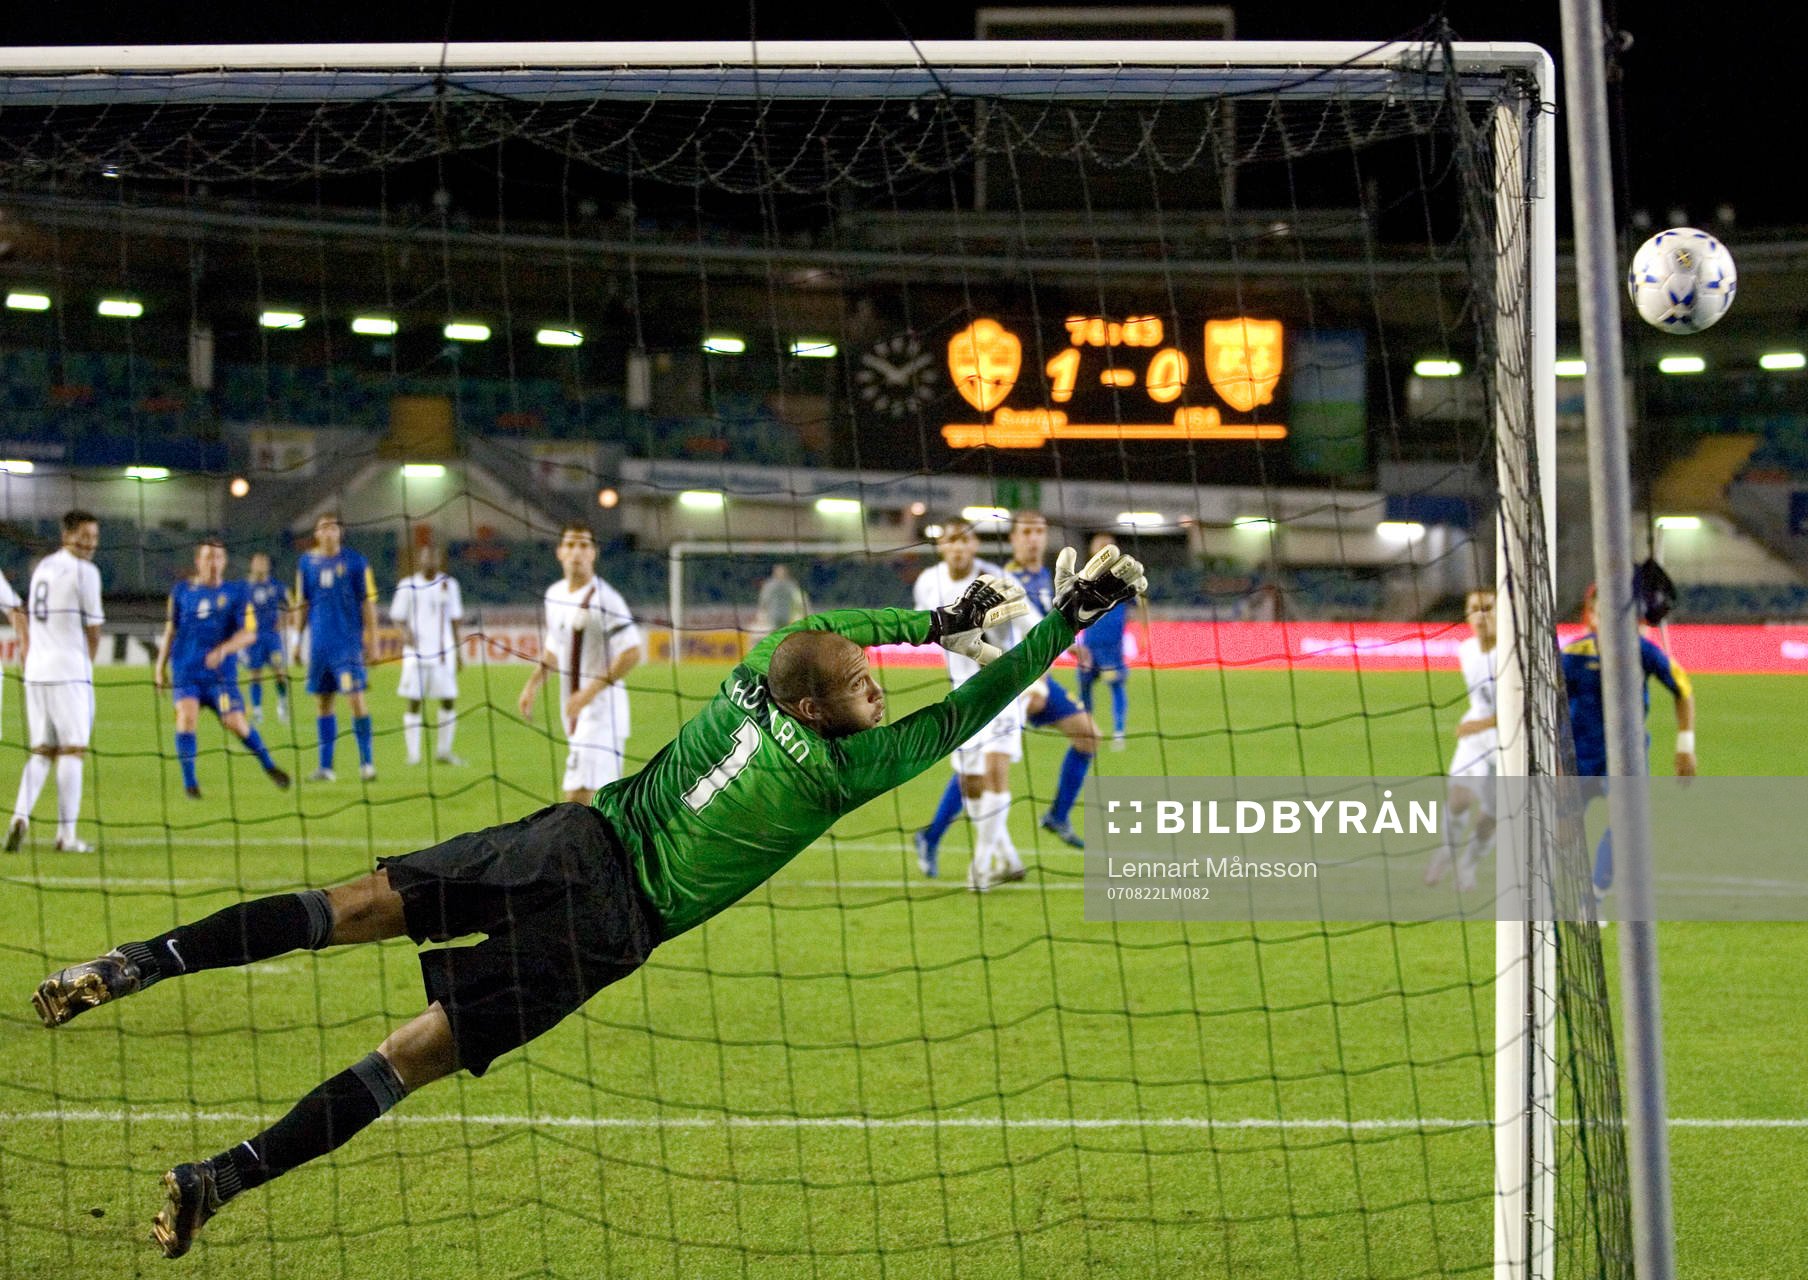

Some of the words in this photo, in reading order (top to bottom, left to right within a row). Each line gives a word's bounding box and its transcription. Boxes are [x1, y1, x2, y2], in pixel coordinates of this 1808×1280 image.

[1047, 348, 1081, 402] 1
[1147, 348, 1188, 402] 0
[34, 579, 49, 622] 8
[680, 715, 762, 816] 1
